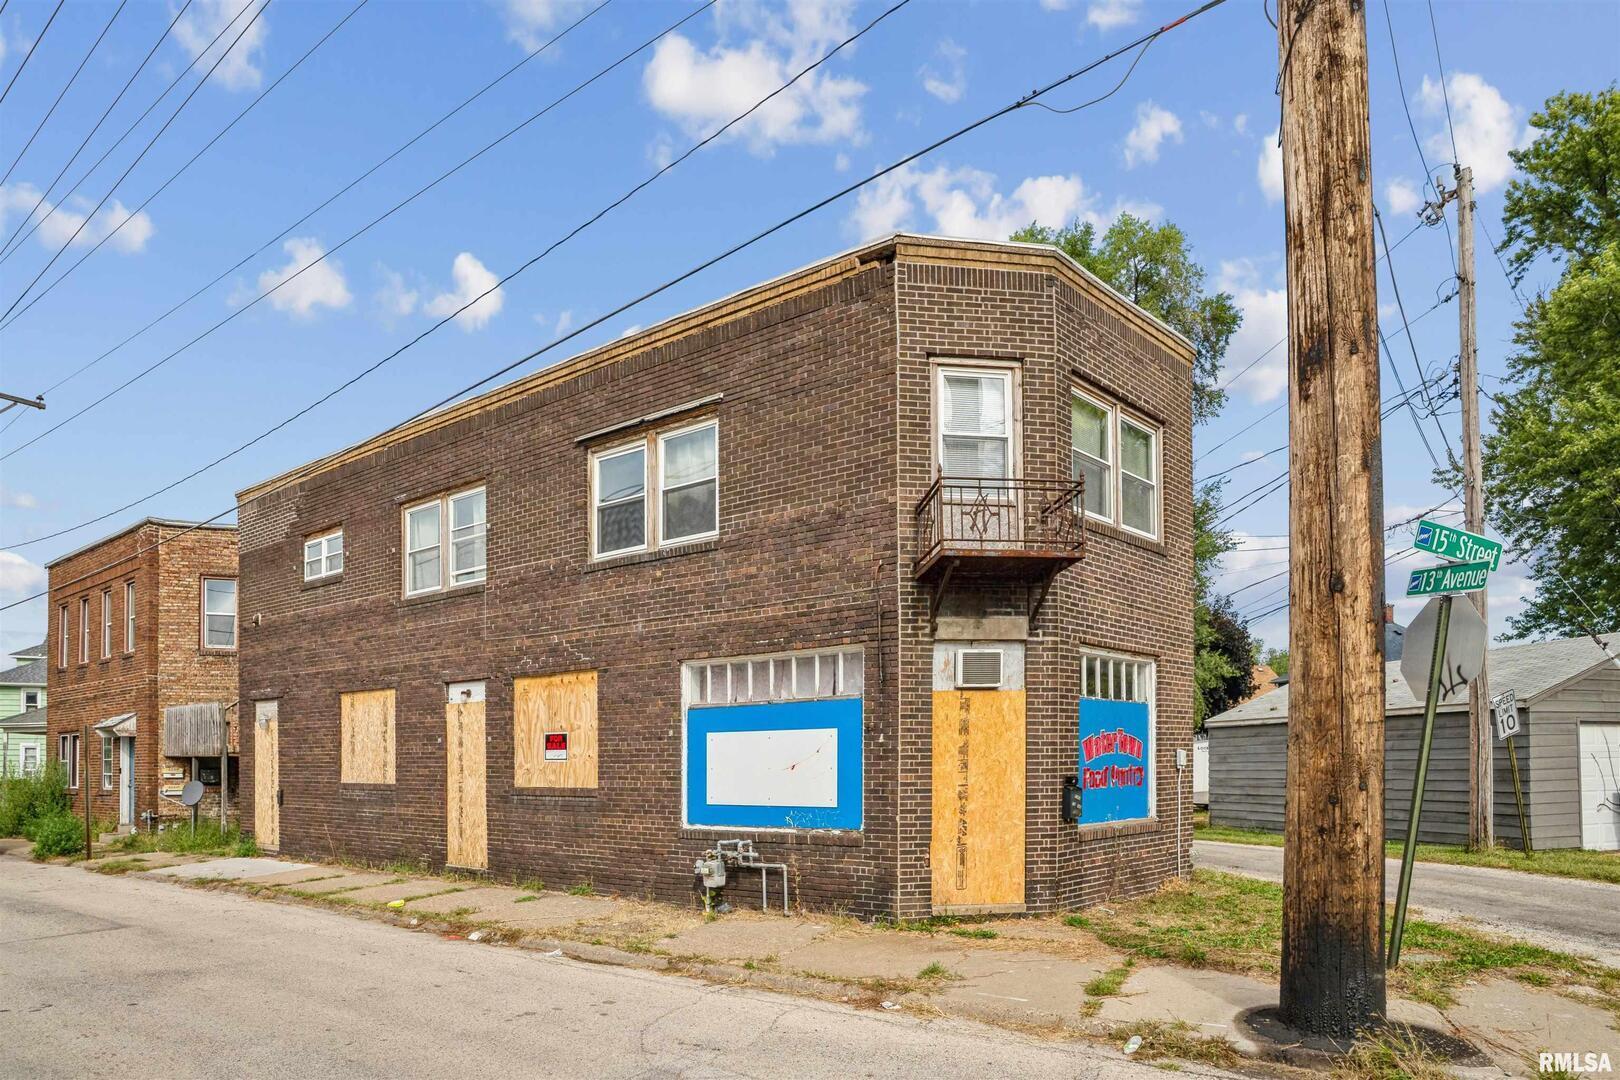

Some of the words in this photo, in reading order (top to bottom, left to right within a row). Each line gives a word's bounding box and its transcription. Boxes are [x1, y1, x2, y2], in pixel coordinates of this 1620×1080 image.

[1432, 528, 1457, 552] 15th
[1456, 535, 1498, 567] Street
[1420, 570, 1443, 591] 13th
[1440, 569, 1487, 590] Avenue
[1495, 693, 1514, 708] SPEED
[1498, 704, 1514, 717] LIMIT
[1500, 714, 1516, 734] 10
[546, 742, 567, 750] SALE
[549, 734, 563, 742] FOR
[1083, 765, 1109, 790] Food
[1110, 764, 1145, 788] Pantry
